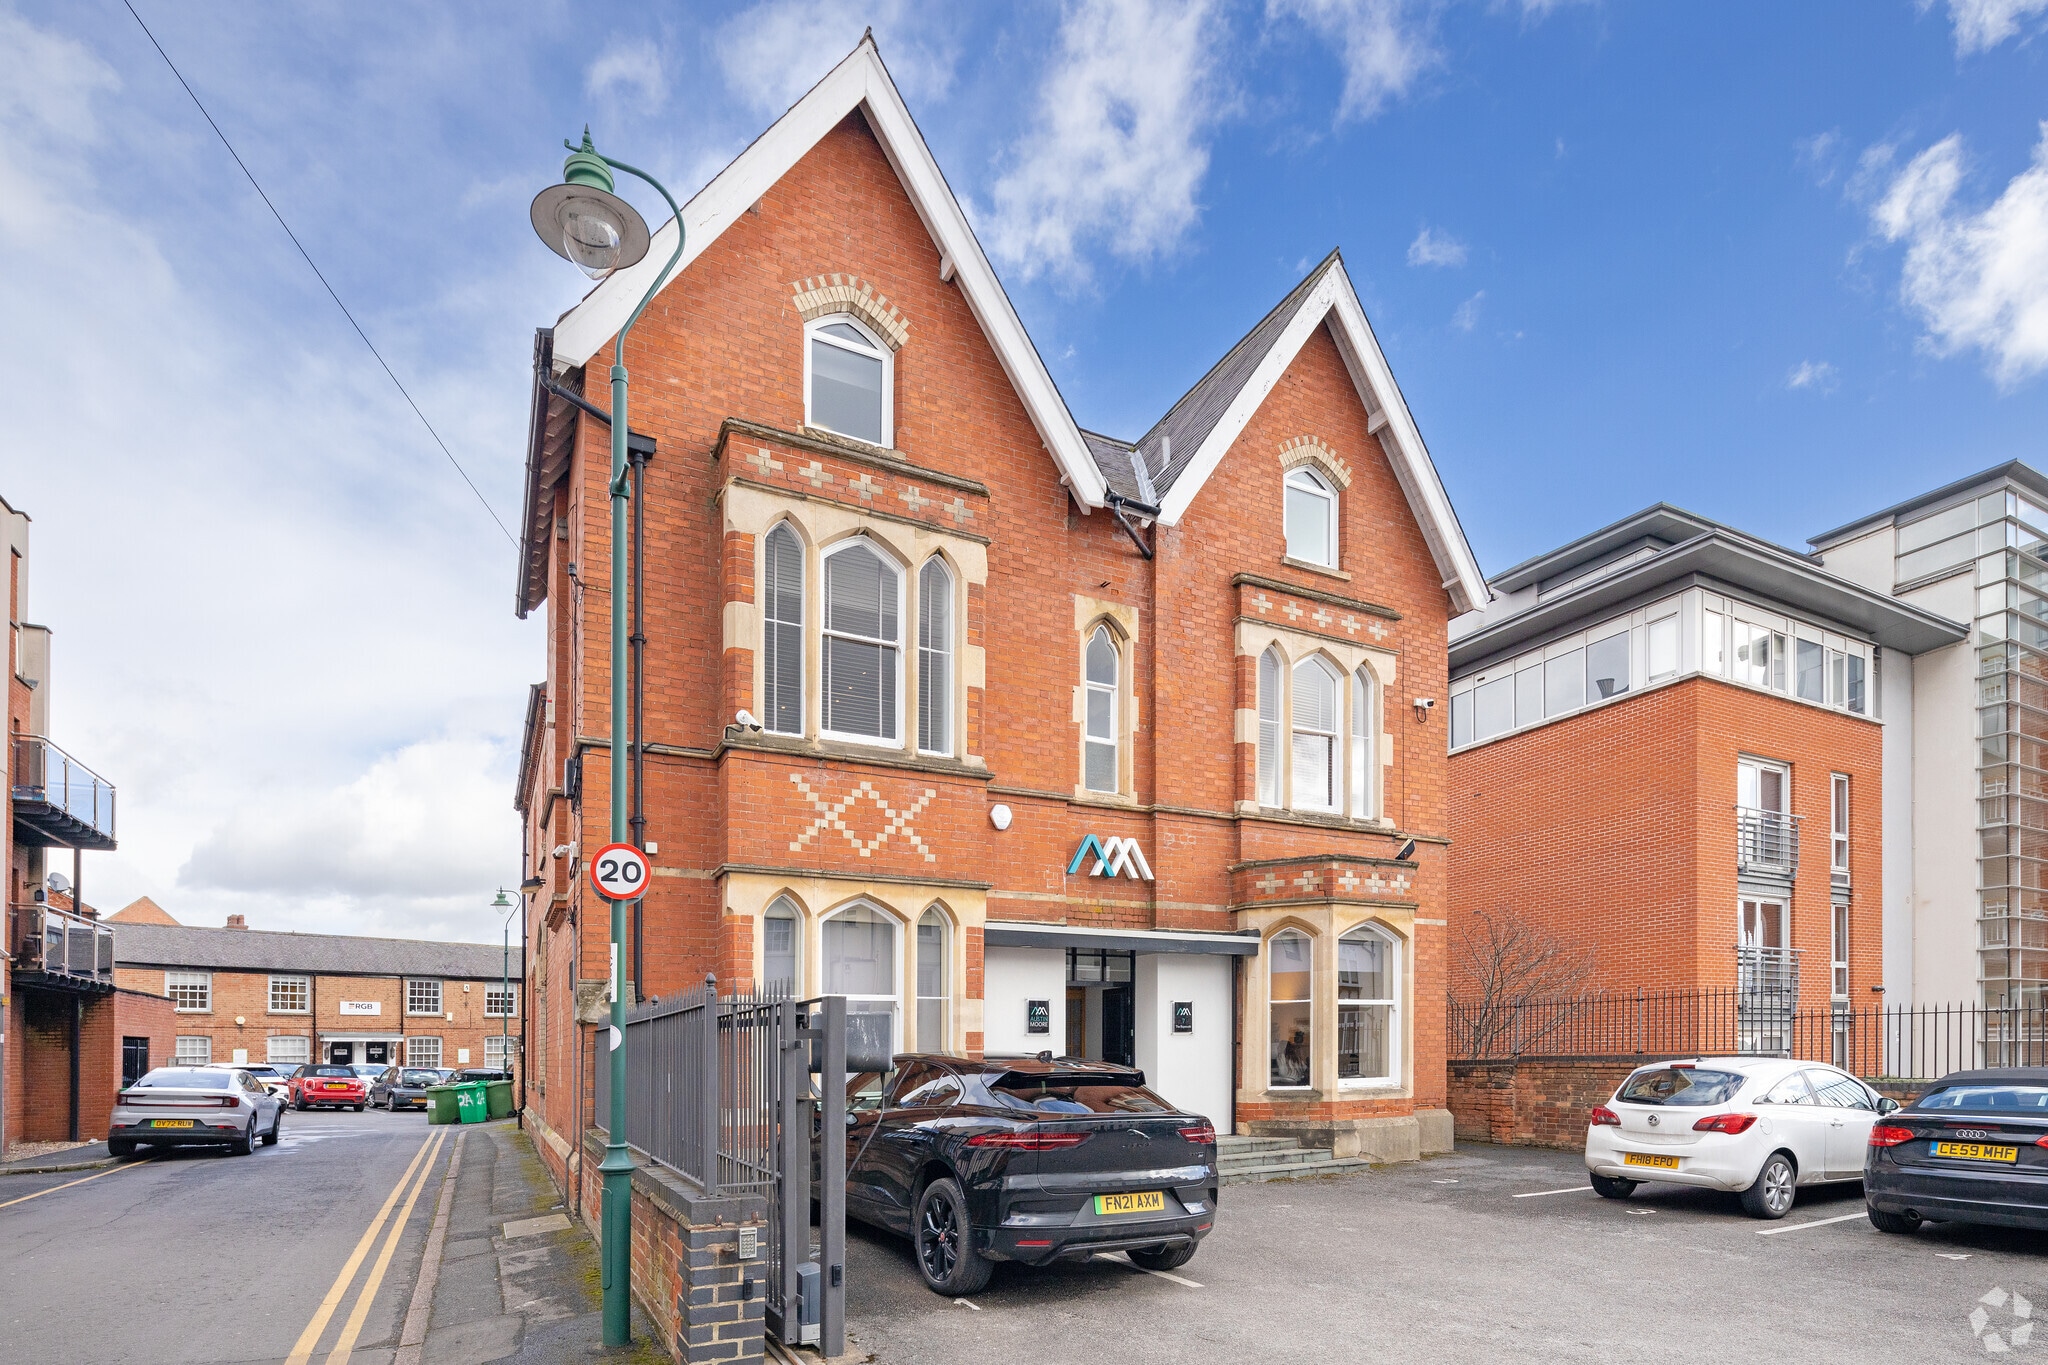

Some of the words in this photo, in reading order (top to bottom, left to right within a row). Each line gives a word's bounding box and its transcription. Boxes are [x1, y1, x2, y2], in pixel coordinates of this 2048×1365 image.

[600, 859, 642, 884] 20
[1940, 1143, 1979, 1156] CE59
[1983, 1146, 2015, 1158] MHF
[1630, 1154, 1652, 1164] FH18
[1653, 1157, 1673, 1167] EPO
[1105, 1195, 1134, 1210] FN21
[1137, 1193, 1160, 1208] AXM
